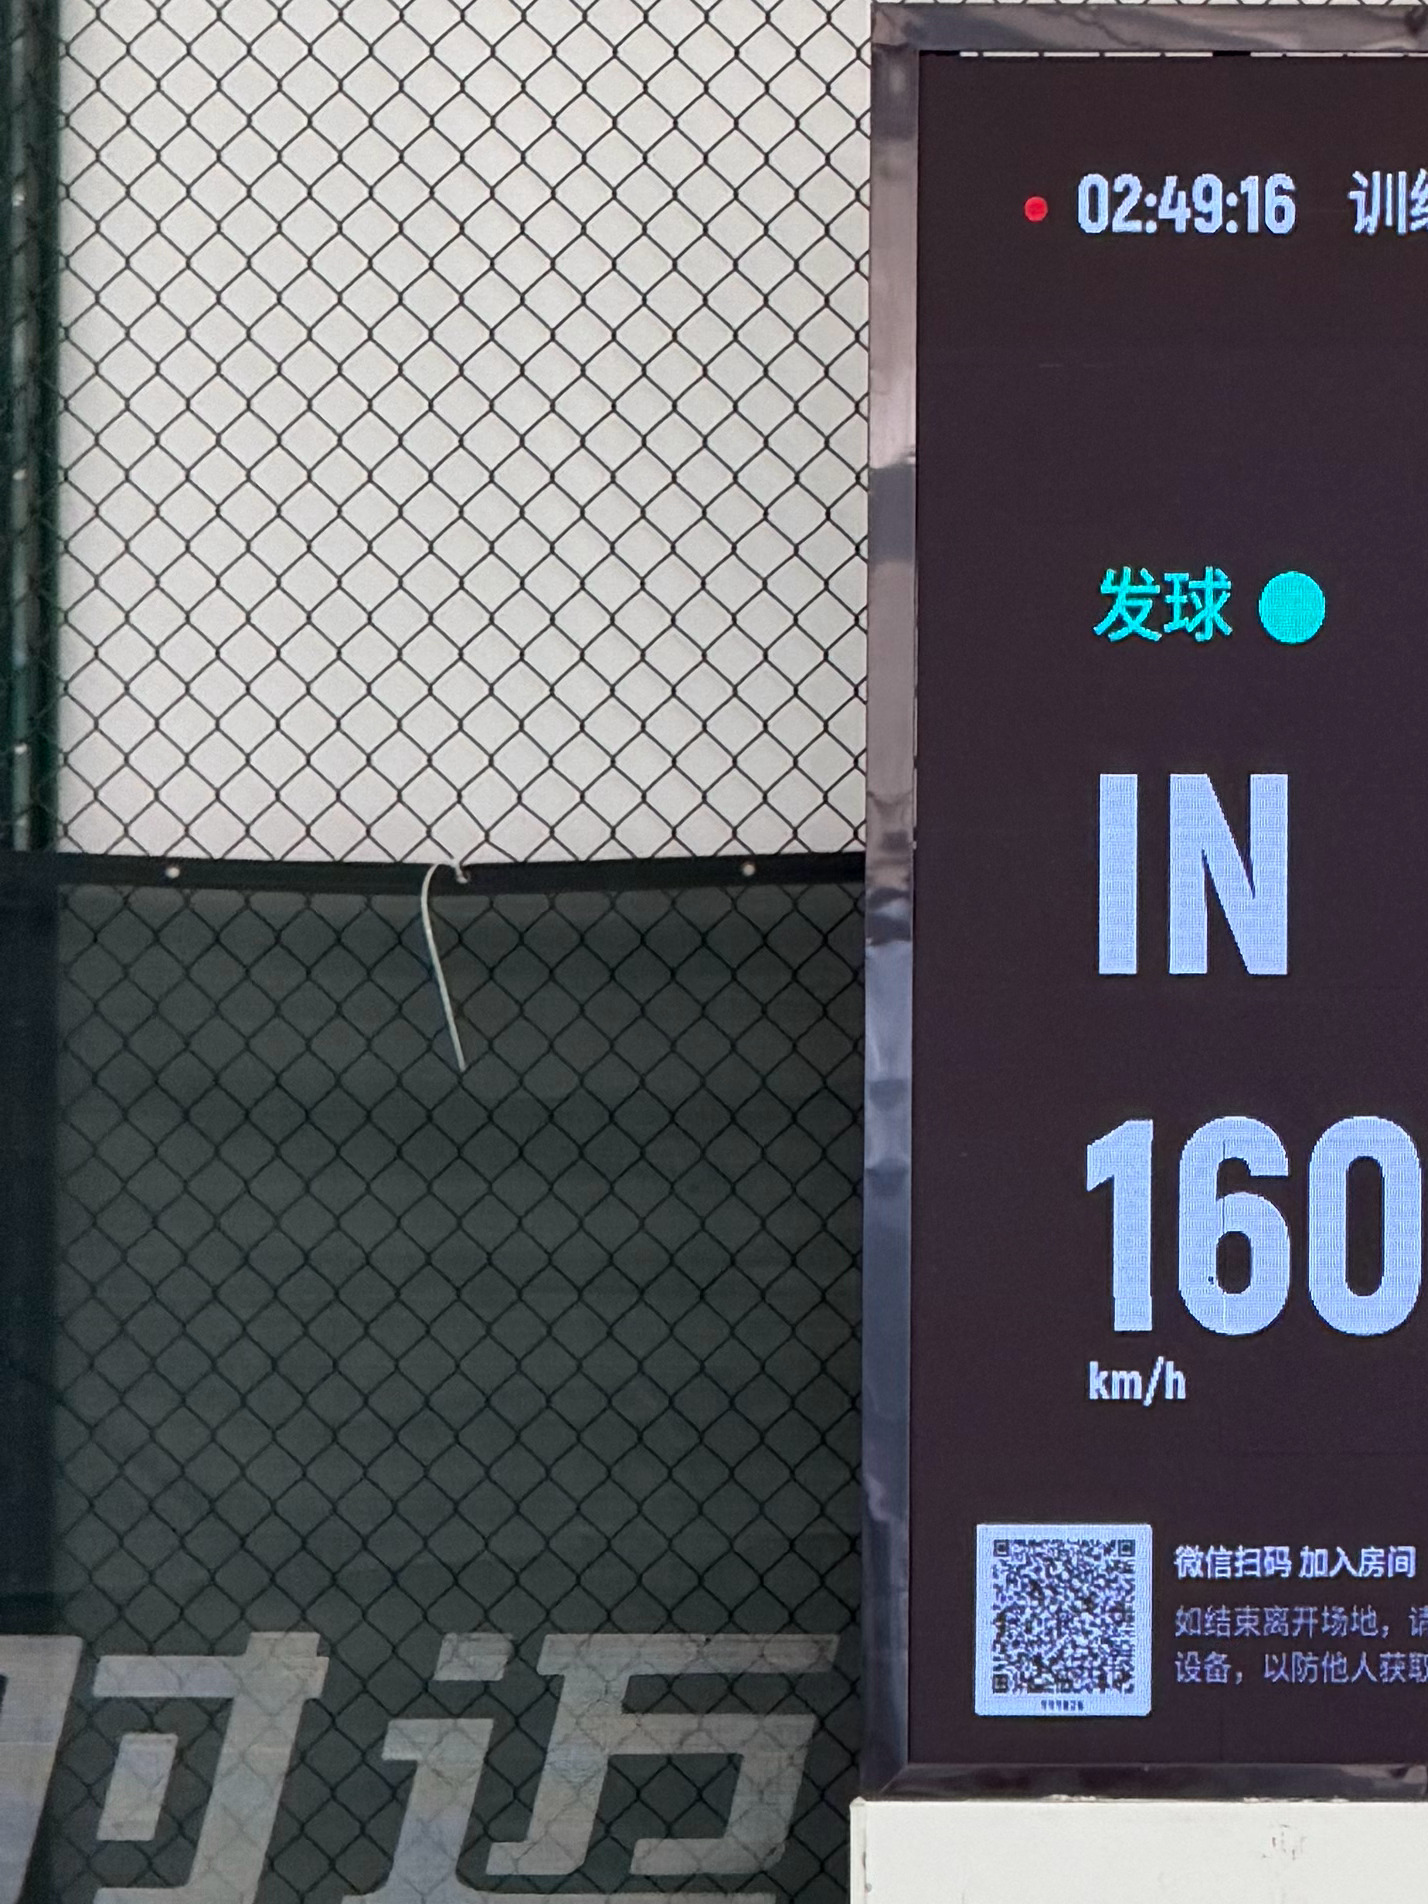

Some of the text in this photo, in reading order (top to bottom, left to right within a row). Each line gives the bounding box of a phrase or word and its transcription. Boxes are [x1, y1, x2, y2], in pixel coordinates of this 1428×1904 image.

[1077, 172, 1297, 235] 02:49:16
[1092, 566, 1233, 643] 发球
[1098, 772, 1289, 976] IN
[1085, 1115, 1423, 1337] 160
[1088, 1355, 1187, 1407] km/h
[1173, 1544, 1417, 1580] 微信扫码 加入房间
